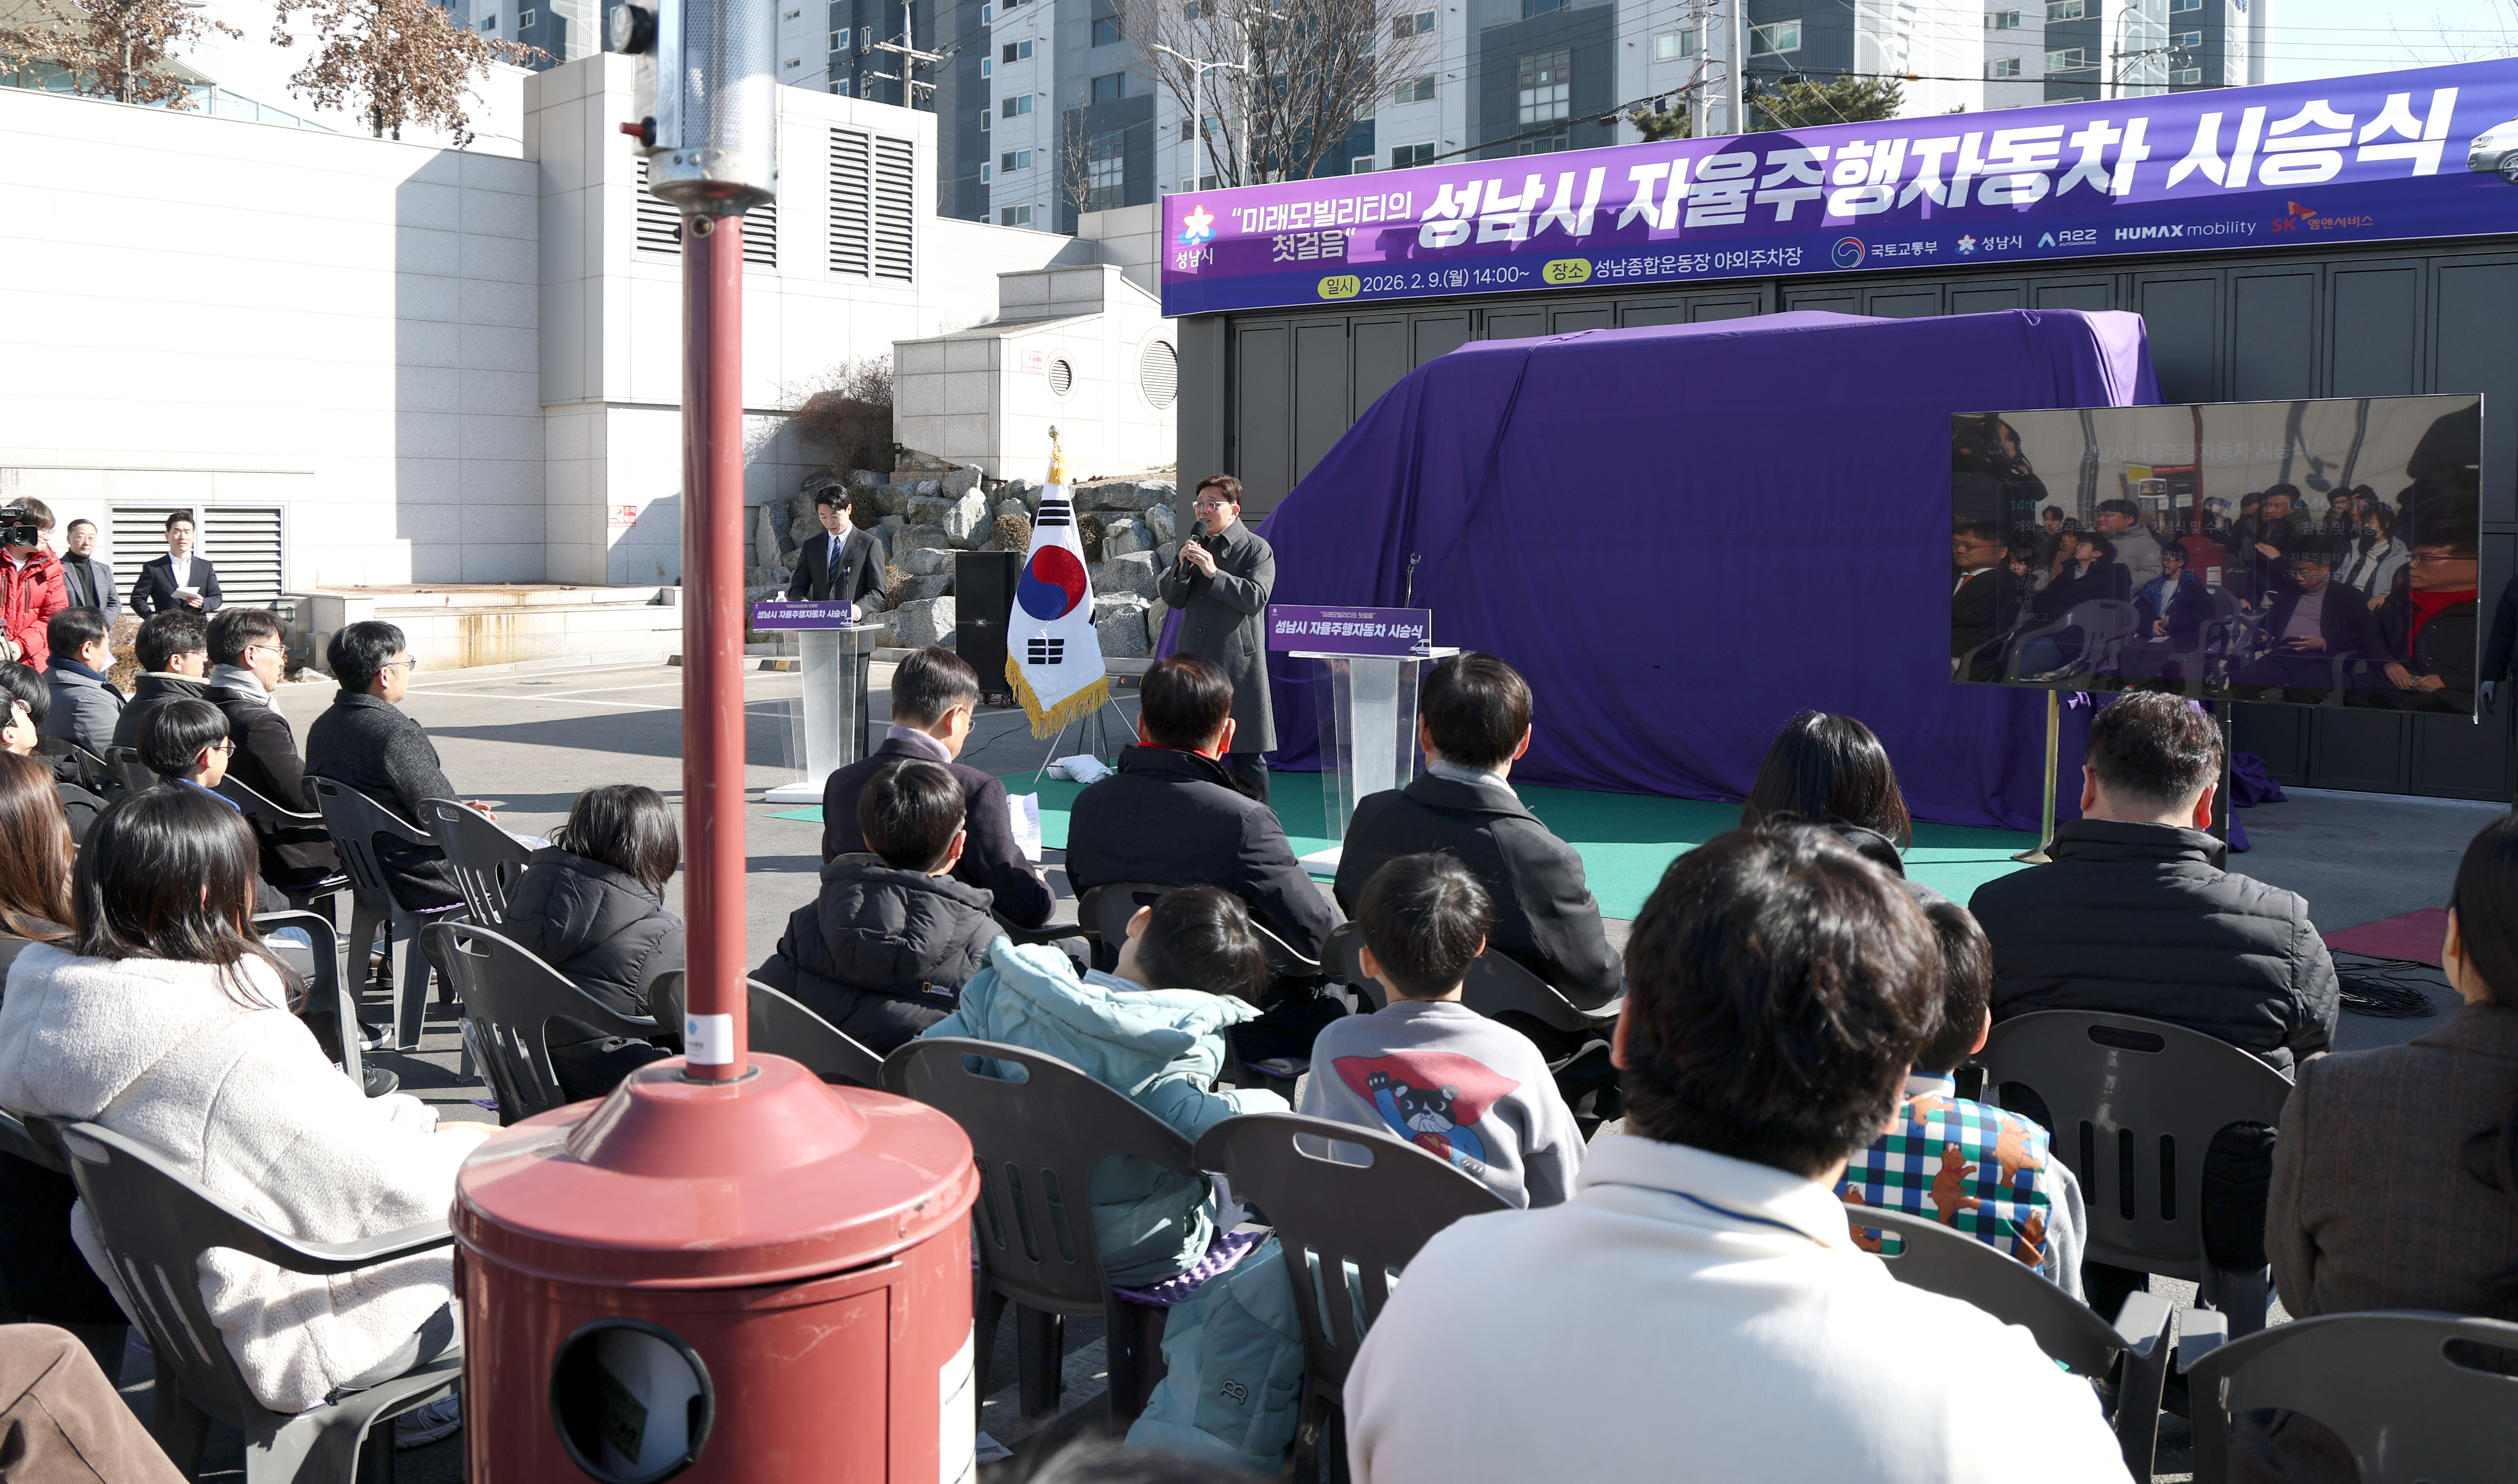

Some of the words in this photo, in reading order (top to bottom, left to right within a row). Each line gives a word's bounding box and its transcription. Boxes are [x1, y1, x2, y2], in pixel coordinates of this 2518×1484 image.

[1419, 166, 1607, 248] 성남시
[1617, 117, 2151, 231] 자율주행자동차
[2166, 87, 2459, 189] 시승식
[2115, 224, 2184, 241] HUMAX
[2187, 220, 2257, 237] mobility
[2272, 217, 2297, 233] SK
[2308, 215, 2375, 231] 엠앤서비스
[1982, 235, 2023, 252] 성남시
[2059, 228, 2097, 242] A2Z
[1871, 241, 1938, 258] 국토교통부
[1176, 247, 1214, 270] 성남시
[1595, 252, 1711, 279] 성남종합운동장
[1715, 246, 1803, 270] 야외주차장
[1363, 276, 1407, 292] 2026.
[1411, 274, 1424, 289] 2.
[1473, 266, 1530, 285] 14:00~
[1552, 263, 1584, 281] 장소
[1327, 278, 1353, 295] 일시
[2132, 441, 2251, 461] 자율주행자동차
[2010, 499, 2048, 511] 14:00
[2015, 520, 2035, 532] 개회
[2190, 521, 2201, 534] 및
[2205, 521, 2229, 534] 수여
[2302, 521, 2329, 535] 참관
[2333, 521, 2345, 535] 및
[2016, 548, 2032, 558] 개회
[2290, 552, 2341, 564] 자율주행차
[2015, 596, 2032, 606] 축사
[757, 610, 777, 619] 성남시
[778, 610, 826, 619] 자율주행자동차
[827, 609, 848, 618] 시승식
[2016, 611, 2049, 622] 경과보고
[1275, 620, 1308, 635] 성남시
[1309, 622, 1386, 638] 자율주행자동차
[1388, 624, 1423, 639] 시승식
[1220, 1379, 1248, 1405] B
